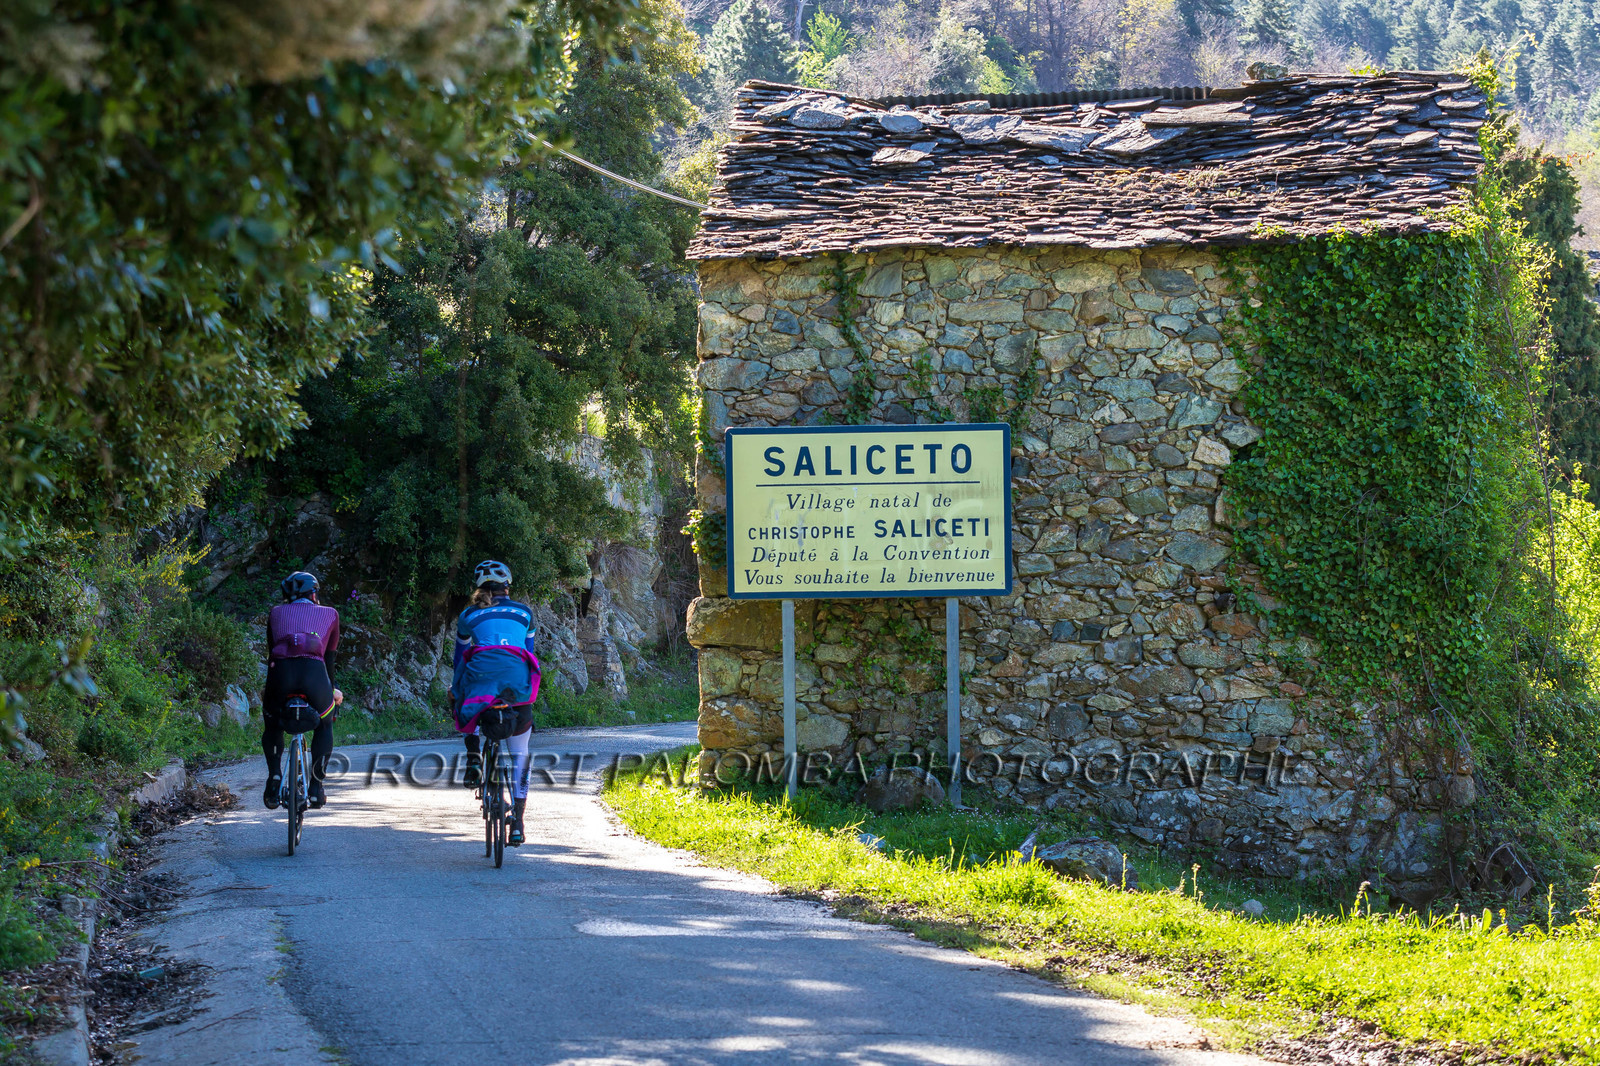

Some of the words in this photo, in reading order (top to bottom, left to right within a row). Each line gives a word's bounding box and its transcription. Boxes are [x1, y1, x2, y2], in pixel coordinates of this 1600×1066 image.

[763, 443, 972, 477] SALICETO
[786, 493, 855, 512] Village
[869, 492, 920, 508] natal
[932, 493, 952, 508] de
[748, 525, 855, 540] CHRISTOPHE
[874, 517, 990, 538] SALICETI
[751, 546, 817, 567] Député
[829, 547, 839, 562] à
[852, 546, 869, 561] la
[883, 544, 990, 561] Convention
[744, 569, 783, 585] Vous
[794, 569, 869, 584] souhaite
[880, 567, 896, 584] la
[908, 567, 995, 583] bienvenue
